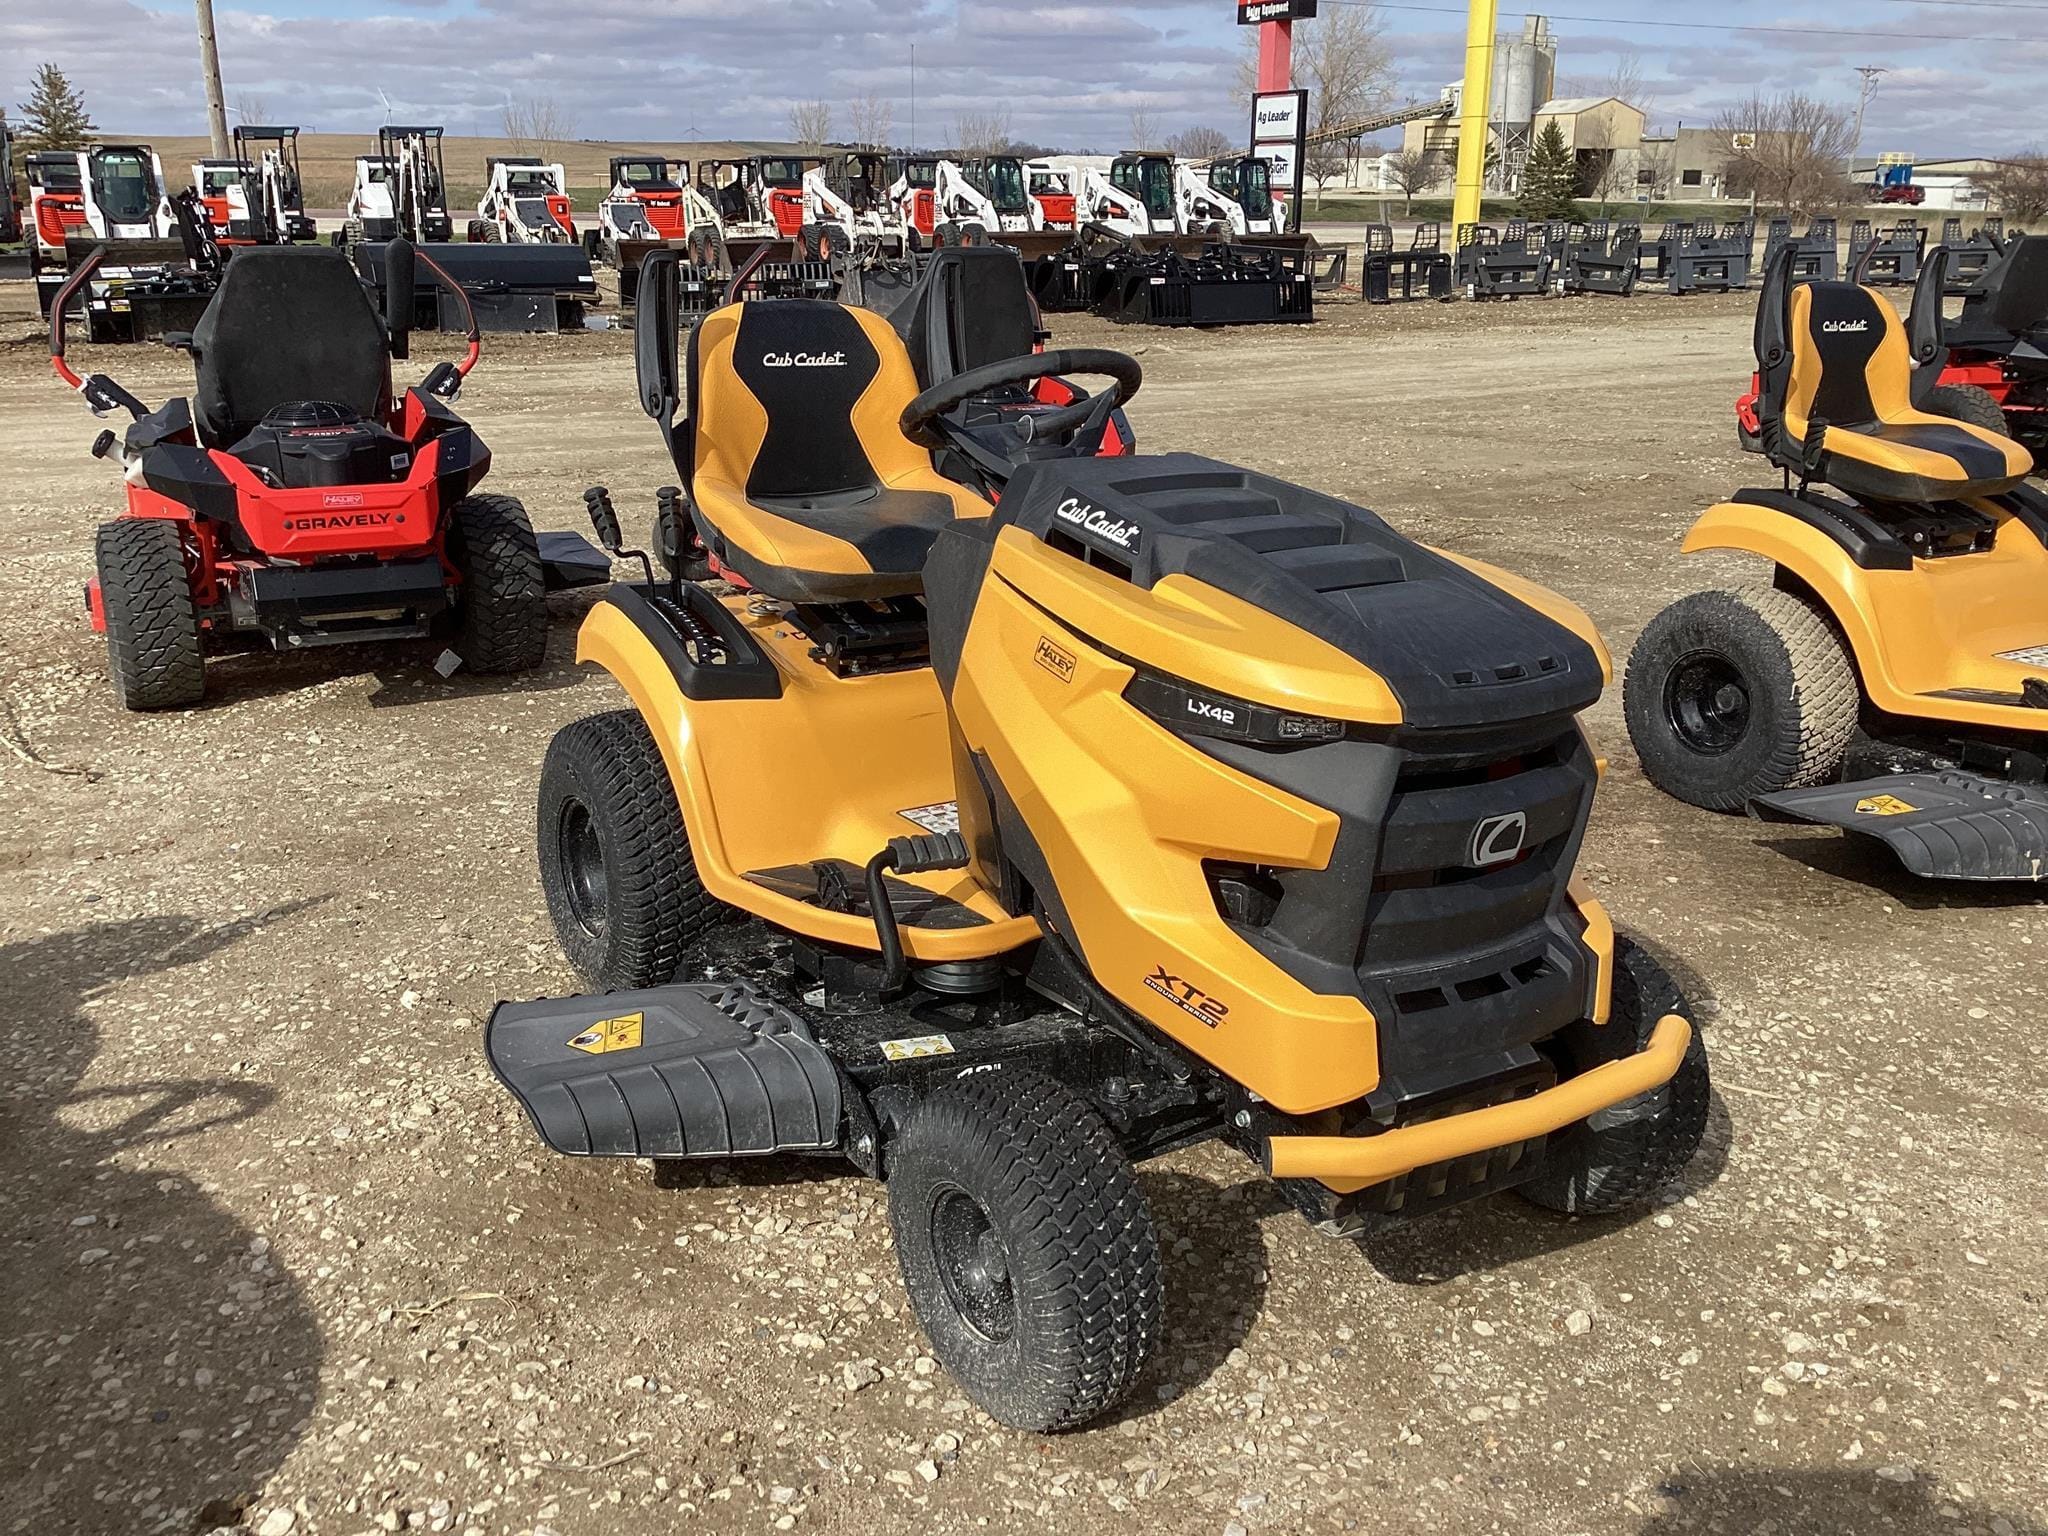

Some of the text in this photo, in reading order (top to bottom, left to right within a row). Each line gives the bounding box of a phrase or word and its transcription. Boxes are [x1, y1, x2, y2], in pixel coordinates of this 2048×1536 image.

[1258, 110, 1291, 124] Ag Leader
[1823, 319, 1868, 332] Cub Cadet
[763, 351, 846, 366] Cub Cadet
[296, 513, 391, 530] GRAVELY
[1057, 498, 1140, 547] Cub Cadet
[1037, 641, 1073, 673] HALEY
[1187, 698, 1235, 725] LX42
[1145, 978, 1213, 1025] ENDURO SERIES
[1148, 964, 1229, 1021] XT2
